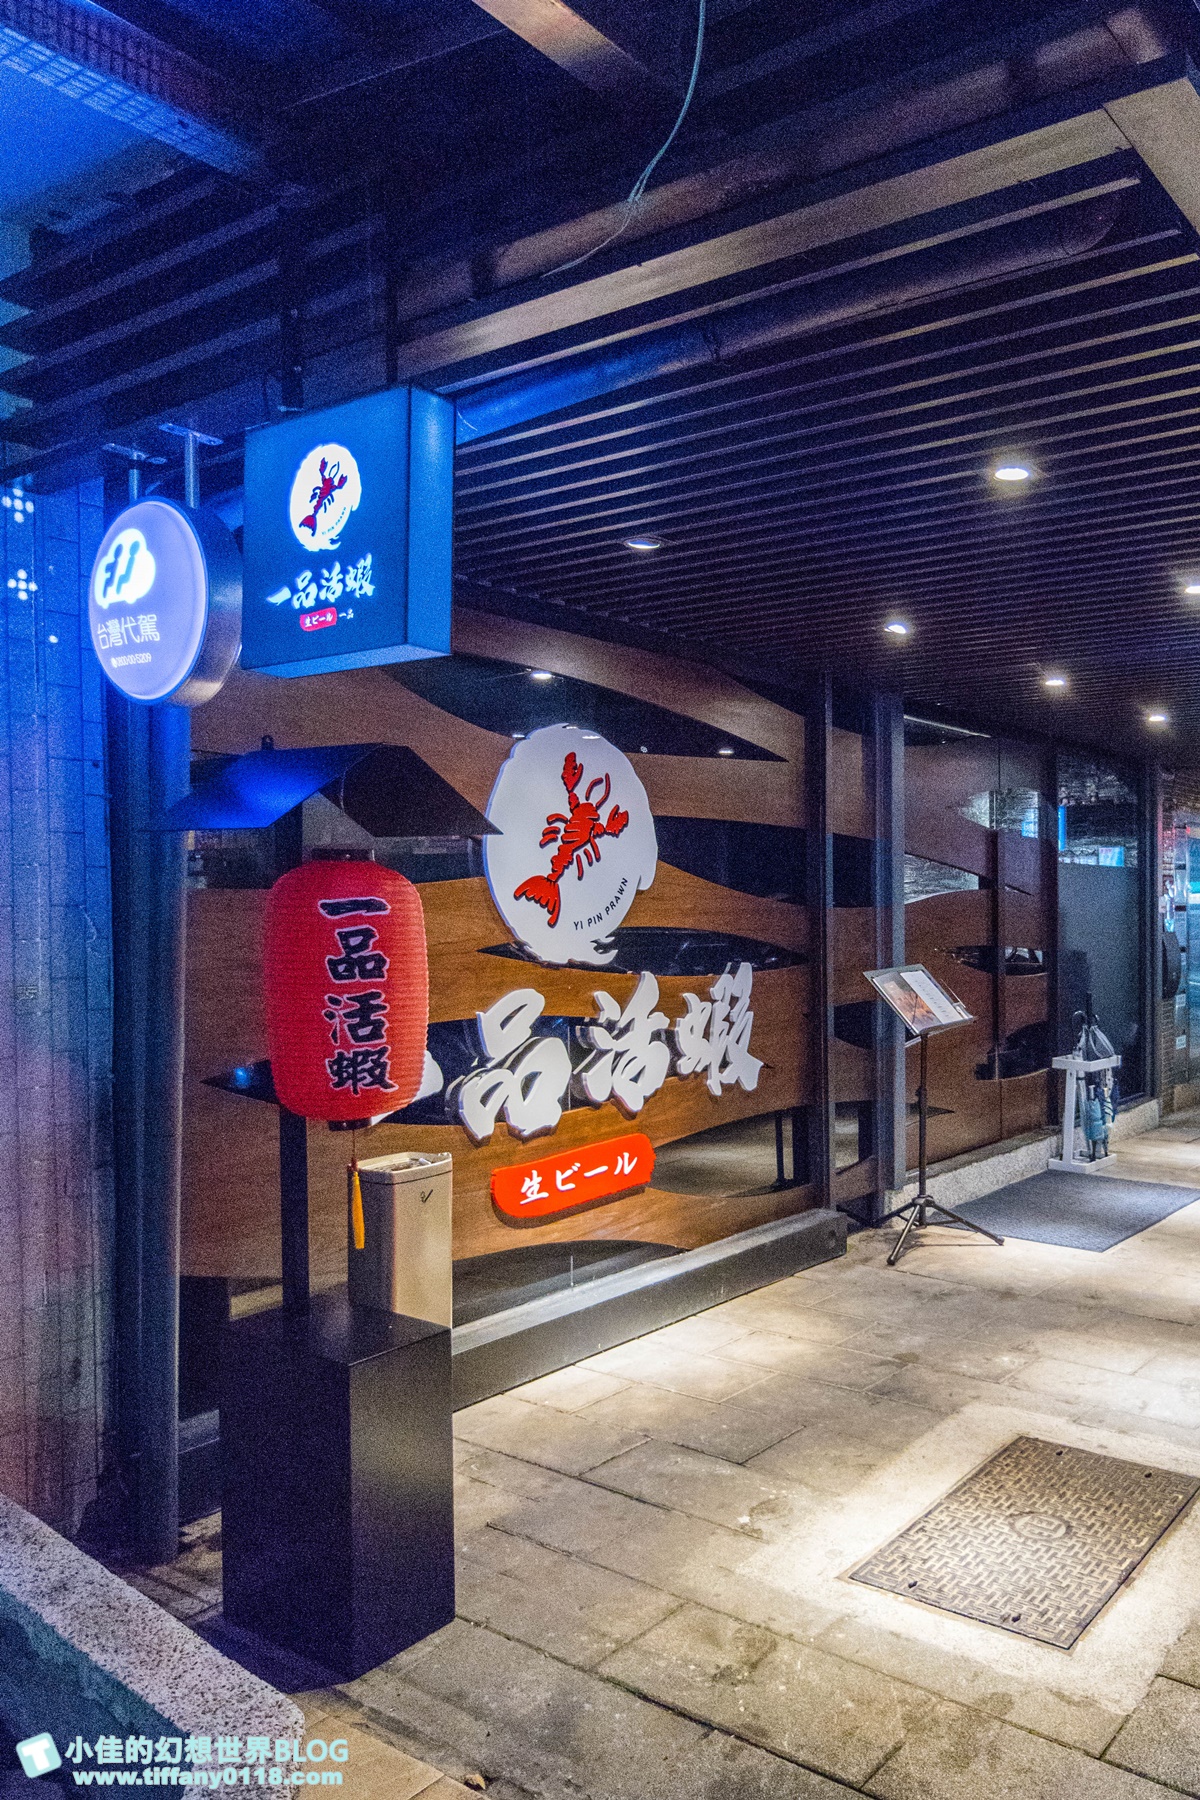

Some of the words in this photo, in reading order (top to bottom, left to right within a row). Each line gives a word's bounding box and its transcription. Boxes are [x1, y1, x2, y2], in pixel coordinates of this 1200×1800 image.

[266, 553, 375, 609] 一品活蝦
[97, 614, 160, 650] 台灣代駕
[304, 612, 333, 628] 生ビール
[573, 920, 584, 931] YI
[587, 912, 604, 928] PIN
[604, 877, 628, 915] PRAWN
[318, 896, 399, 1097] 一品活蝦
[519, 1151, 638, 1205] 生ビール
